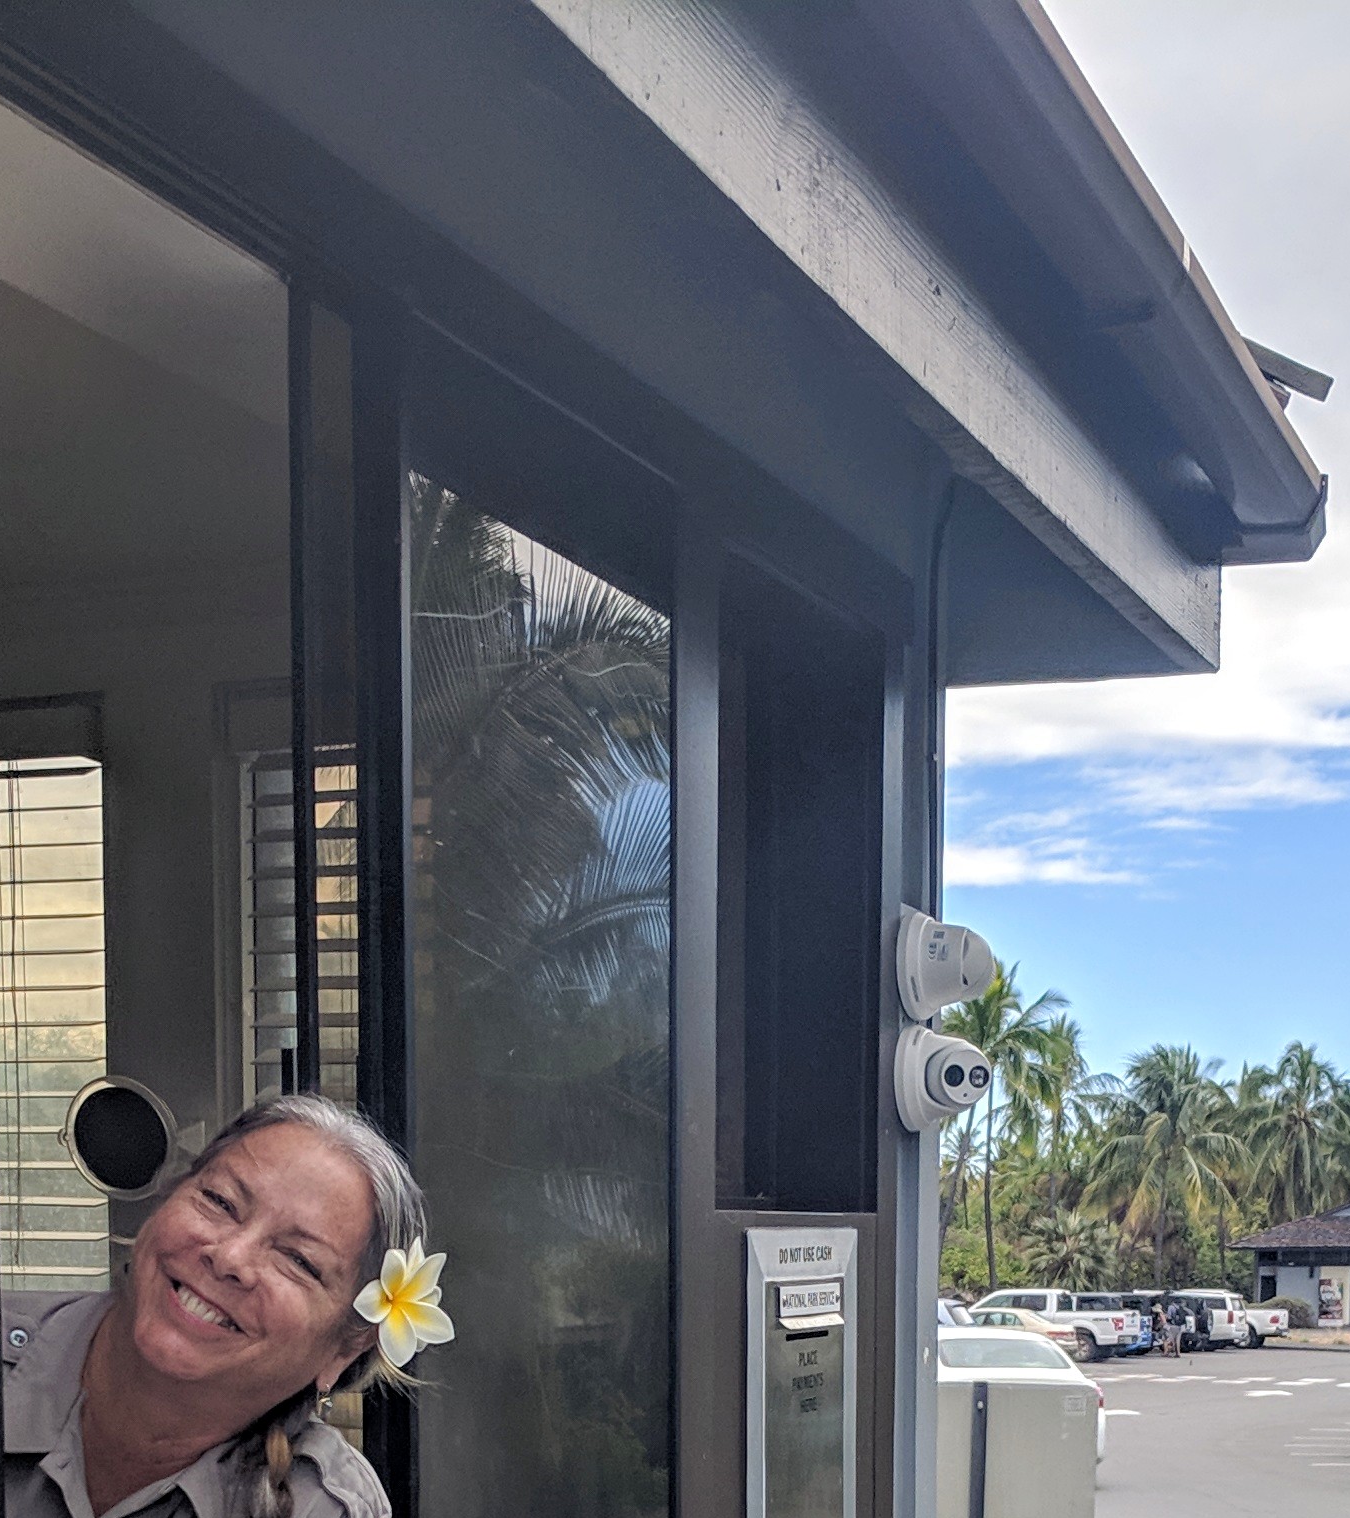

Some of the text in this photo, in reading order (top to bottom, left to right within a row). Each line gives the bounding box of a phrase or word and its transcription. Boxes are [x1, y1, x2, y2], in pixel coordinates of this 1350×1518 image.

[779, 1245, 832, 1264] DO NOT USE CASH
[798, 1350, 818, 1367] PLACE
